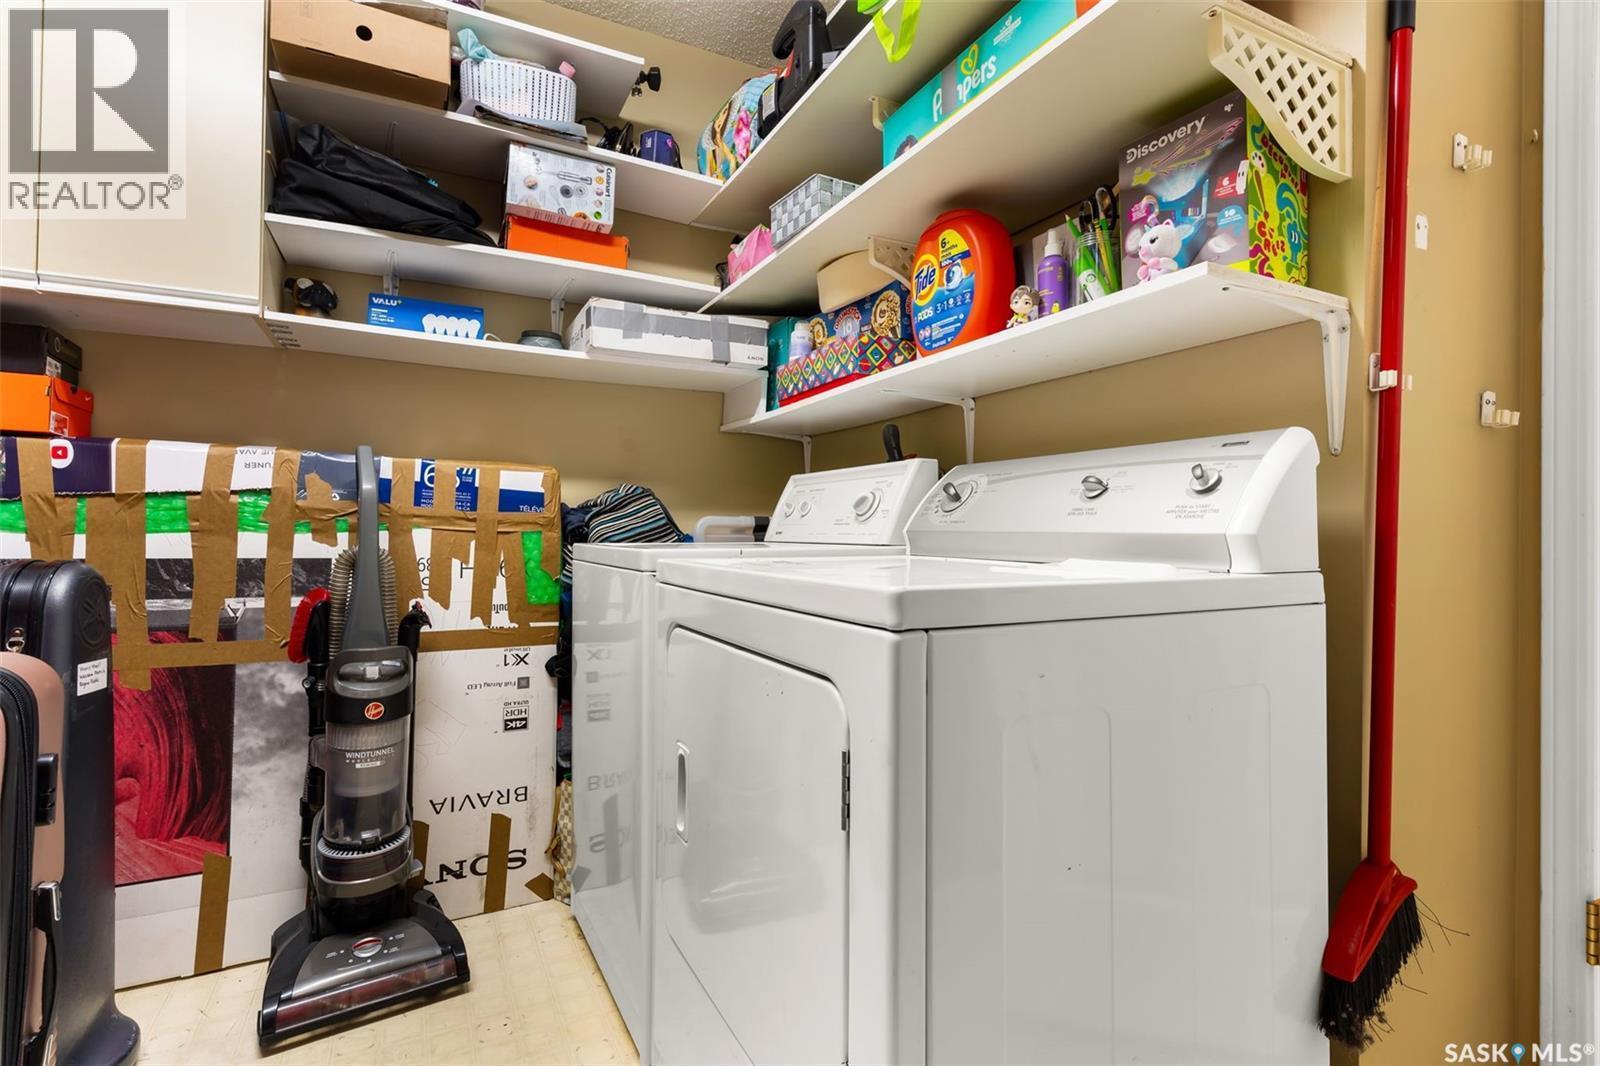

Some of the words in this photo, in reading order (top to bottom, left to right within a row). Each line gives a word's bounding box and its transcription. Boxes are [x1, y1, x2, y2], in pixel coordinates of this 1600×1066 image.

[932, 55, 997, 122] Ppers
[1126, 115, 1206, 165] Discovery
[914, 262, 937, 301] Tide
[504, 708, 528, 717] HDR
[505, 719, 527, 729] 4K
[345, 747, 395, 759] WINDTUNNEL
[429, 785, 528, 815] BRAVIA
[424, 848, 528, 886] SON
